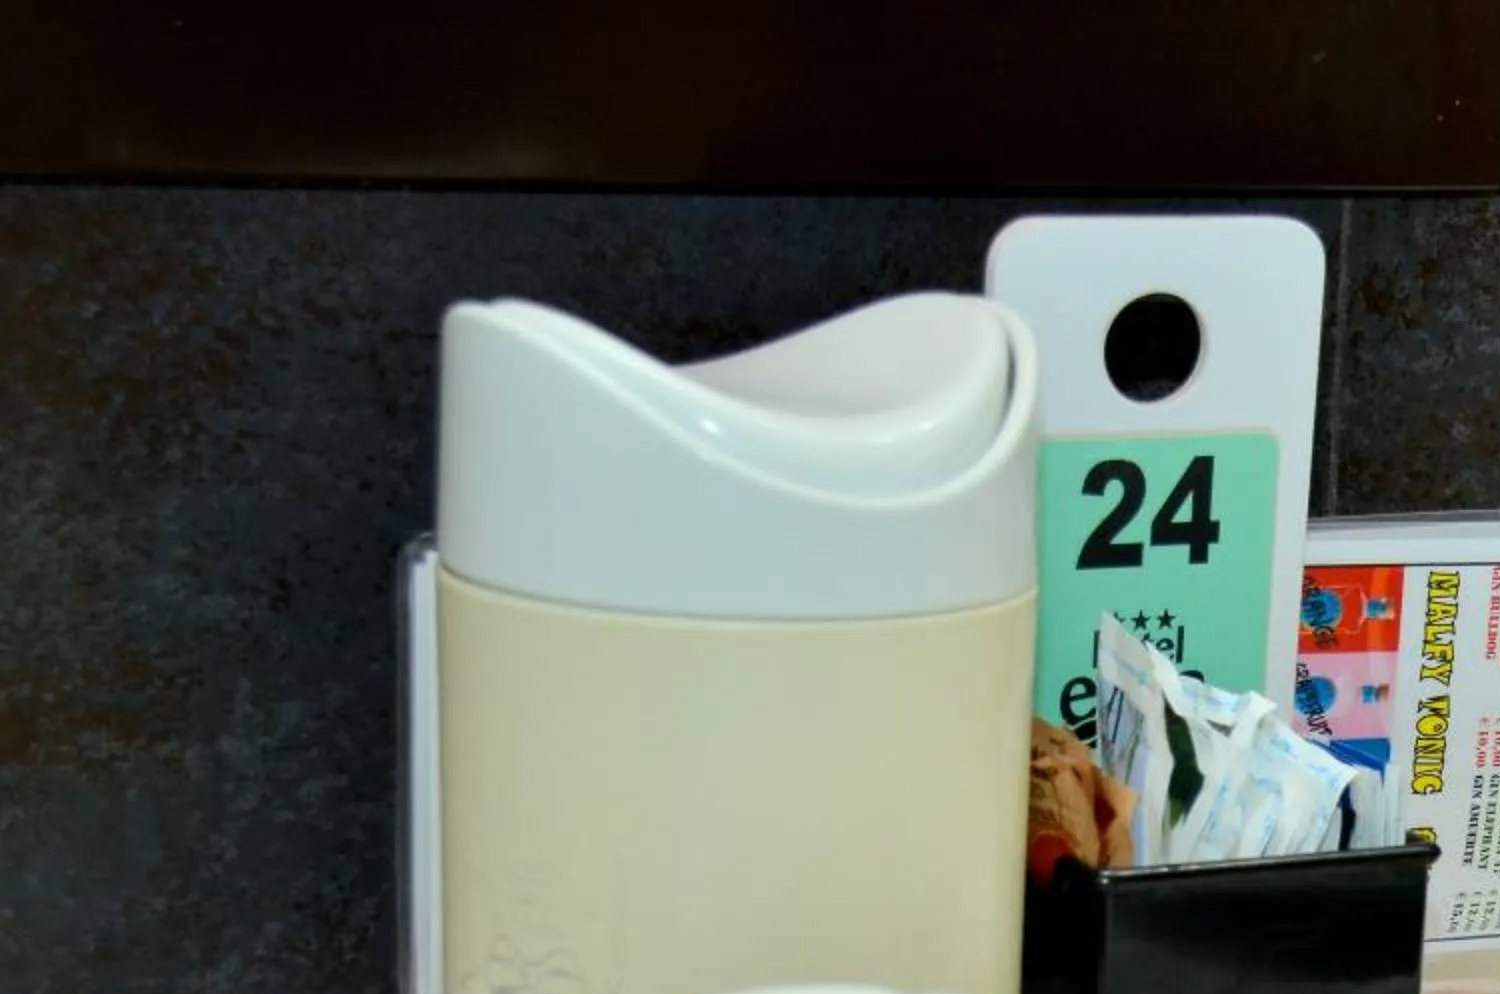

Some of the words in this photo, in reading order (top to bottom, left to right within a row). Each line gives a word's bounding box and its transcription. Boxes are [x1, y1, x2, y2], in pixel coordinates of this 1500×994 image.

[1076, 455, 1220, 570] 24
[1420, 571, 1460, 686] MALFY
[1486, 596, 1500, 660] BULLDOG
[1412, 696, 1451, 794] TONIC
[1472, 775, 1484, 799] GIN
[1489, 774, 1500, 798] GIN
[1478, 802, 1497, 869] ELEPHANT
